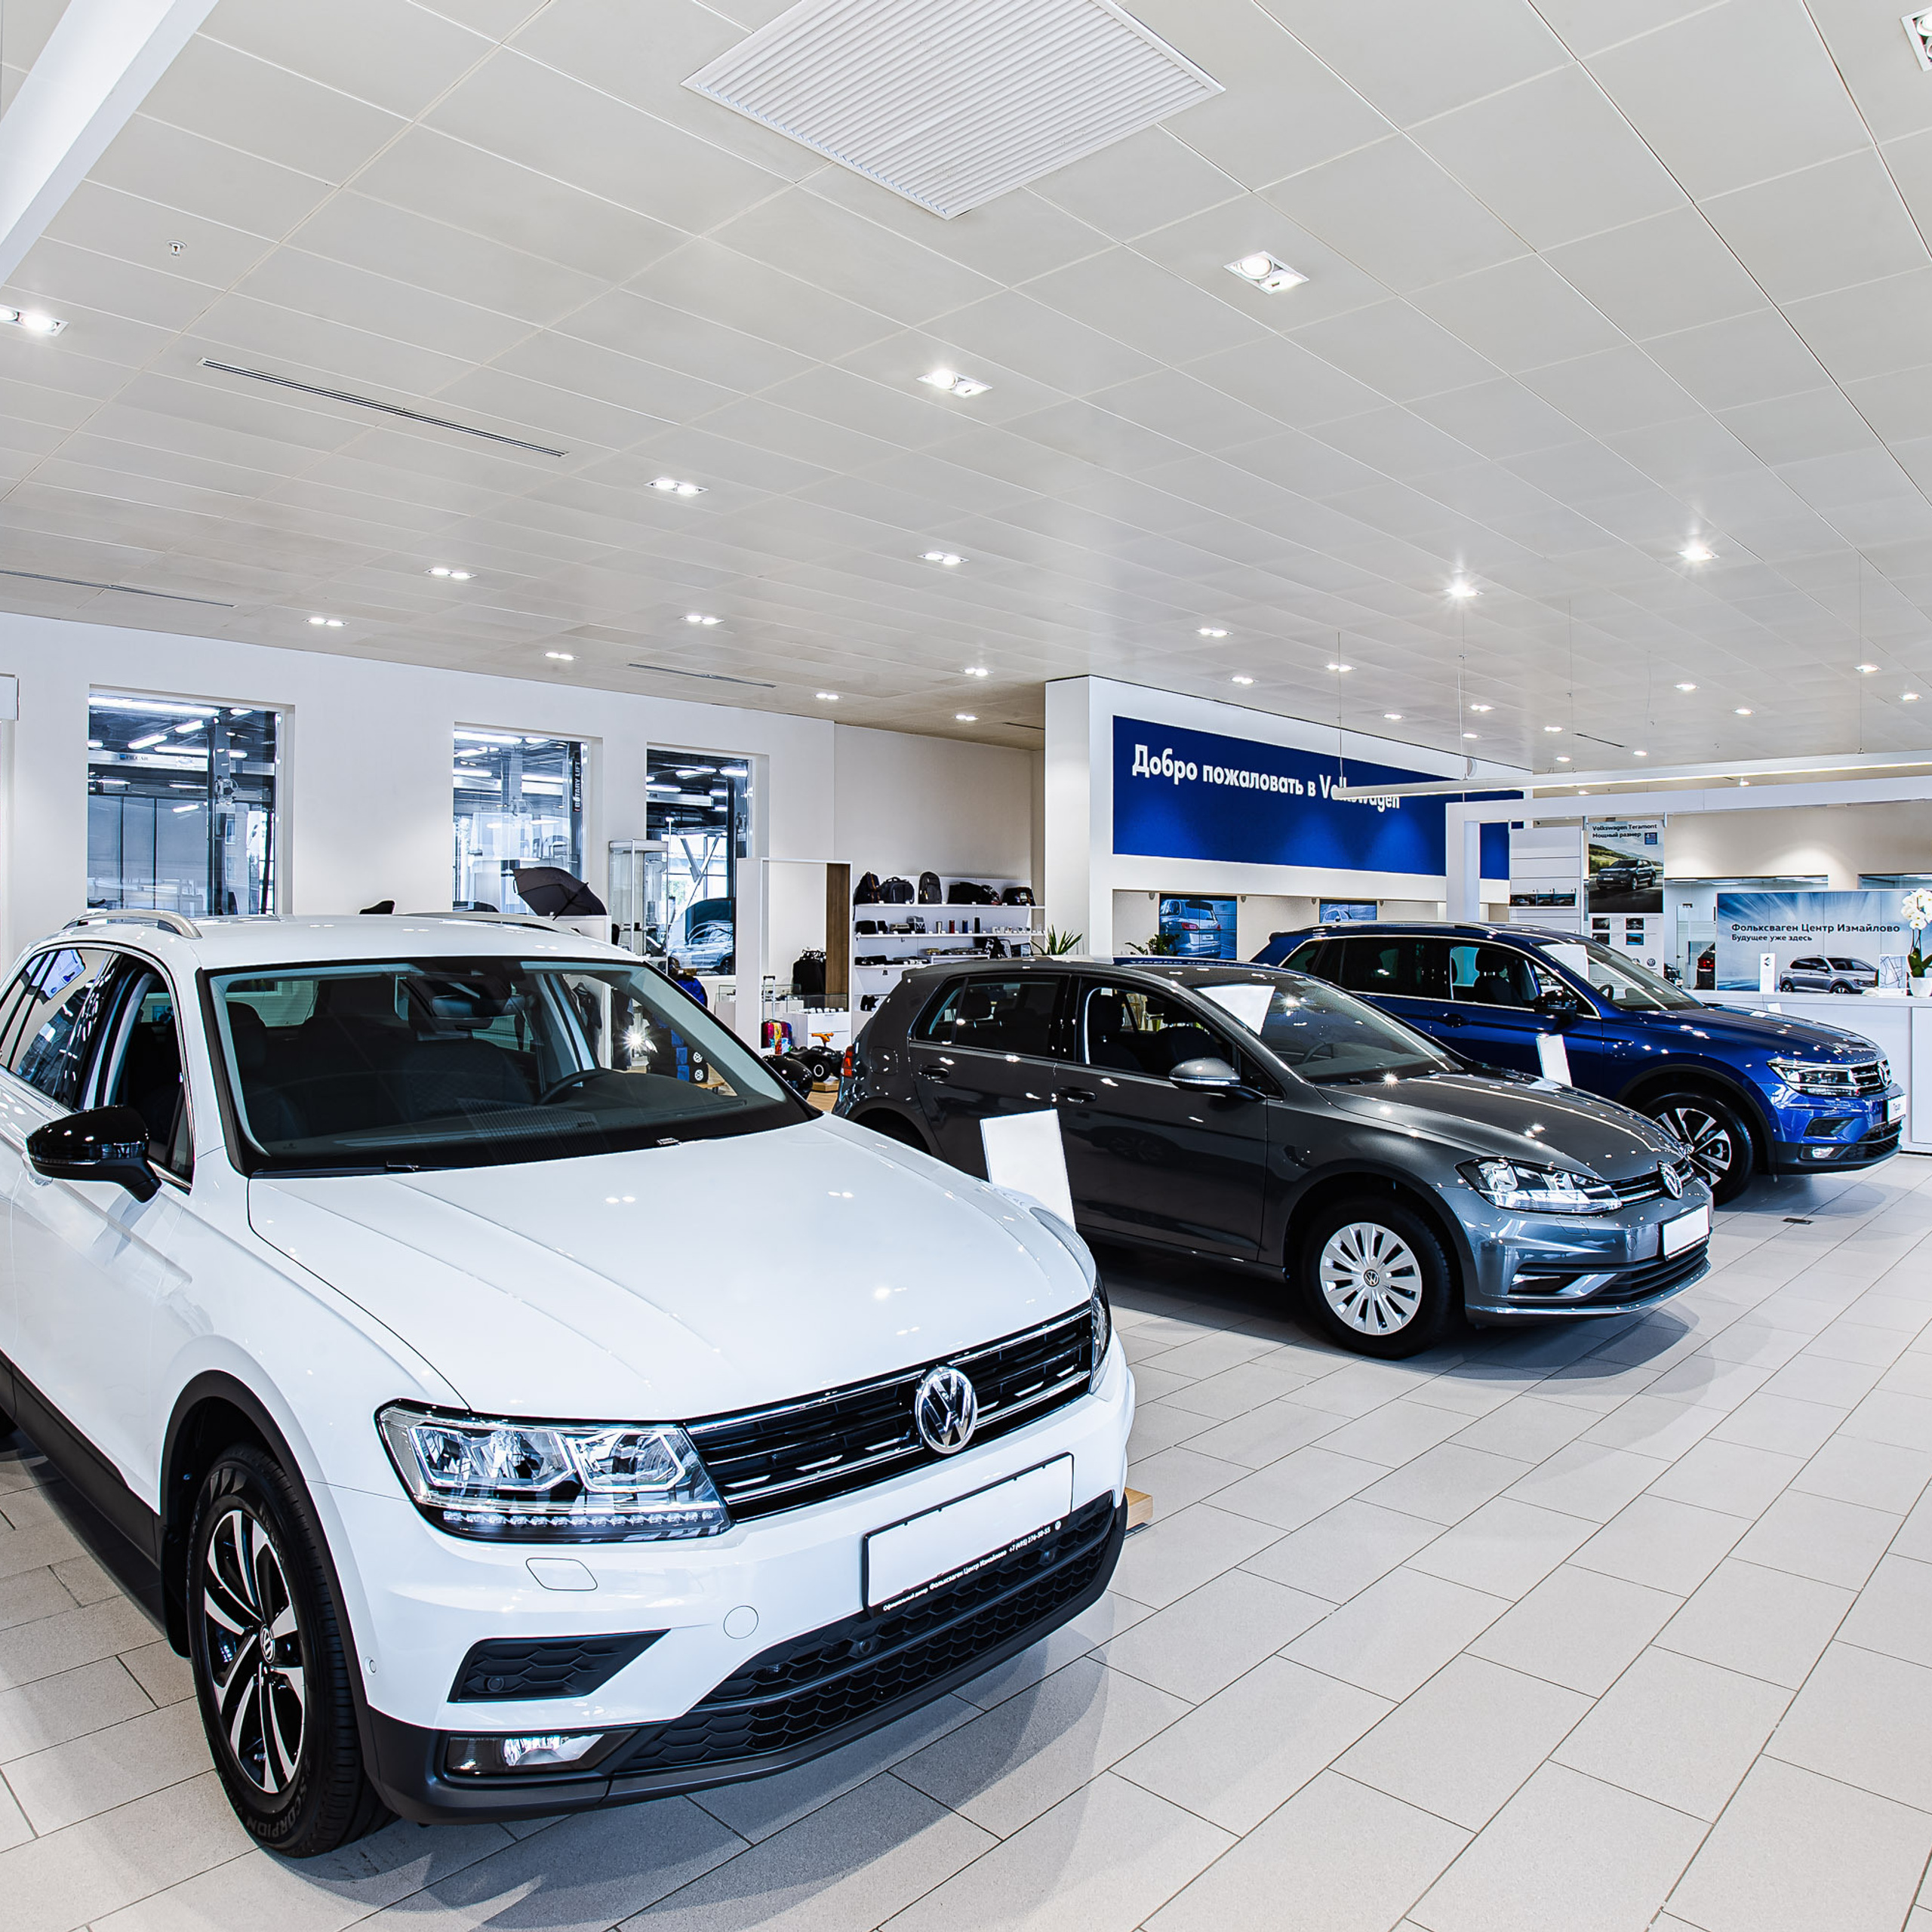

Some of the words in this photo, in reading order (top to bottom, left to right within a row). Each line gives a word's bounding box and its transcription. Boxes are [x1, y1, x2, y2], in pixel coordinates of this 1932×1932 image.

[1132, 744, 1198, 785] Добро
[1202, 764, 1304, 795] пожаловать
[1308, 780, 1316, 797] в
[1319, 774, 1400, 812] Vagen
[1731, 923, 1798, 932] Фольксваген
[1801, 924, 1835, 934] Центр
[1837, 923, 1900, 932] Измайлово
